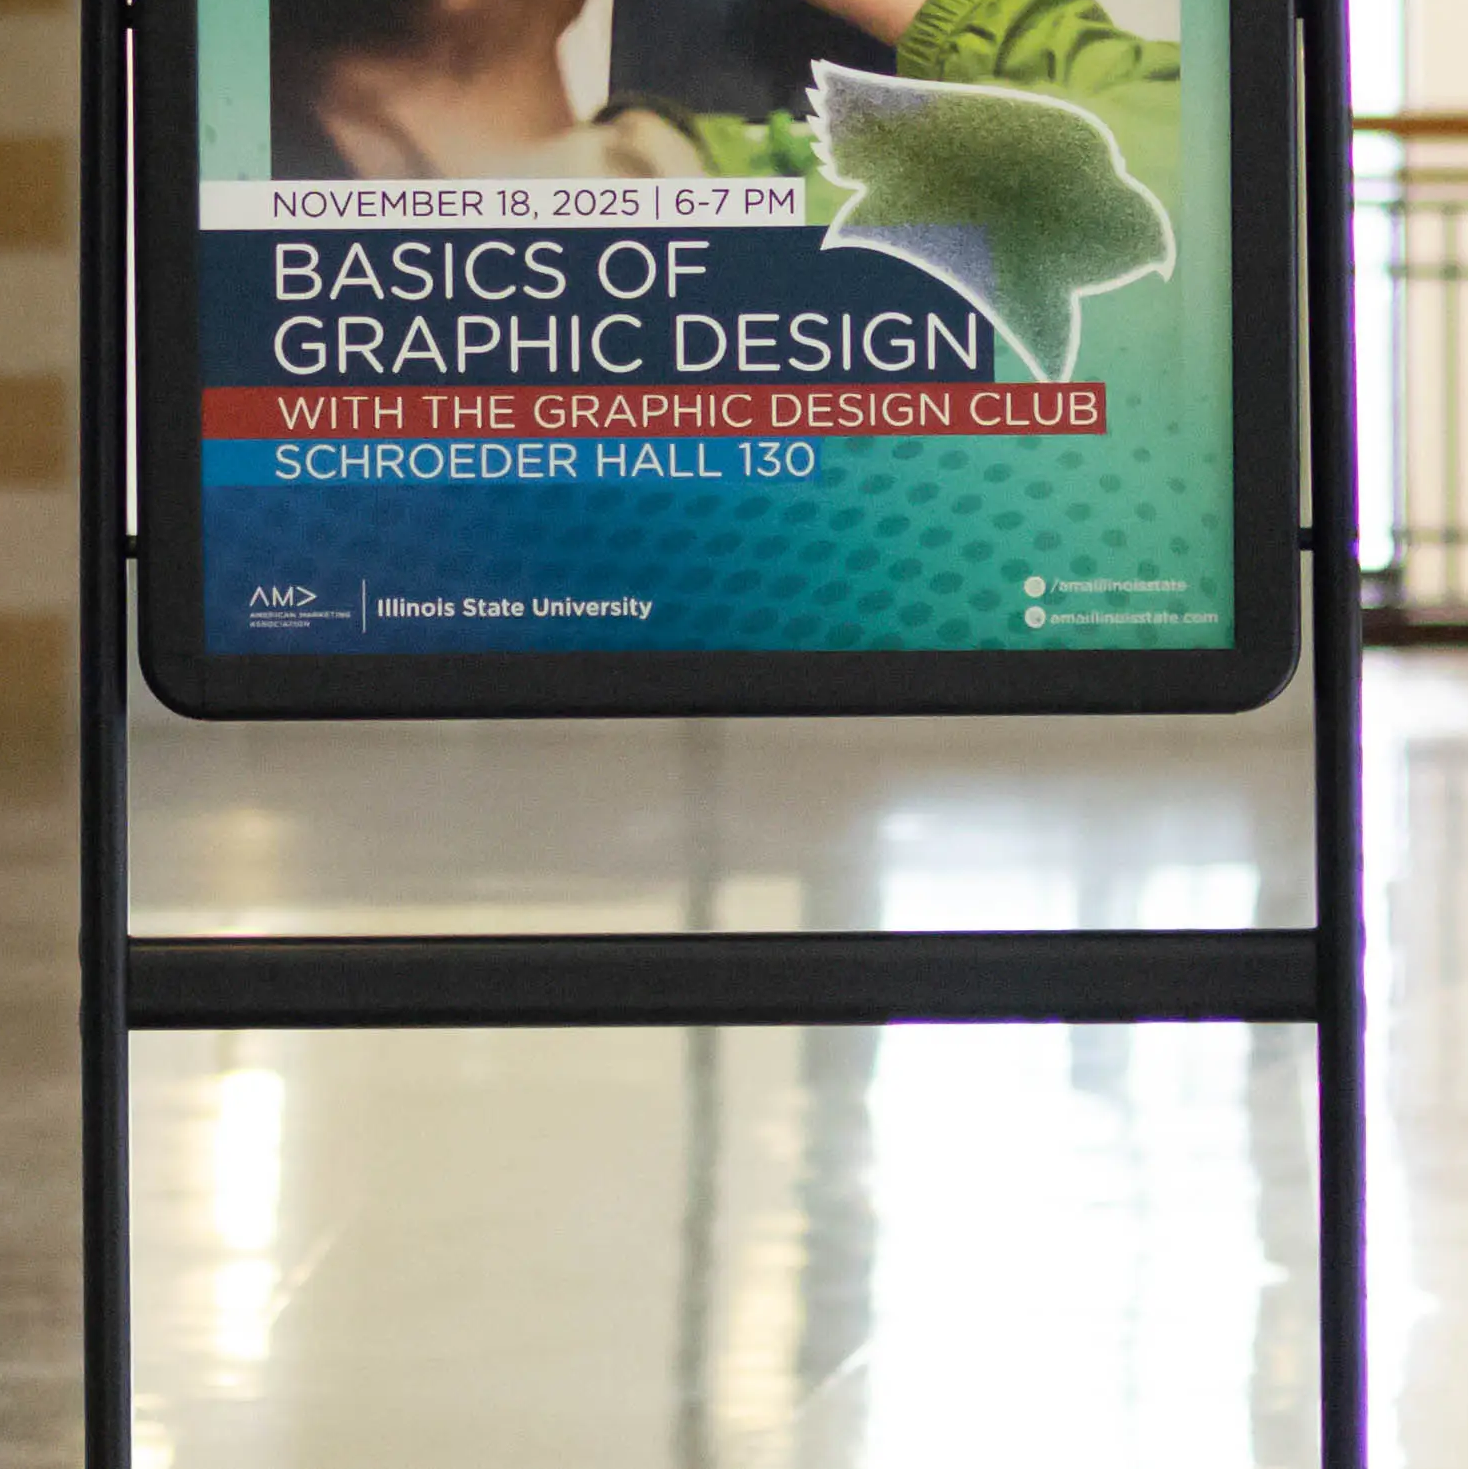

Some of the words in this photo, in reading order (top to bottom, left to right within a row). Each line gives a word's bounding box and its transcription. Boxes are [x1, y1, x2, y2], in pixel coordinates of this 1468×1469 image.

[274, 190, 483, 218] NOVEMBER
[497, 189, 539, 219] 18,
[553, 189, 640, 216] 2025
[675, 188, 730, 216] 6-7
[745, 188, 795, 215] PM
[275, 241, 567, 301] BASICS
[598, 240, 710, 299] OF
[274, 314, 643, 375] GRAPHIC
[675, 311, 978, 372] DESIGN
[277, 395, 404, 430] WITH
[422, 395, 516, 429] THE
[534, 394, 753, 429] GRAPHIC
[771, 392, 951, 427] DESIGN
[969, 391, 1099, 426] CLUB
[275, 443, 578, 480] SCHROEDER
[596, 443, 723, 478] HALL
[738, 441, 816, 477] 130
[377, 597, 456, 618] Illinois
[461, 598, 526, 618] State
[532, 596, 653, 621] University
